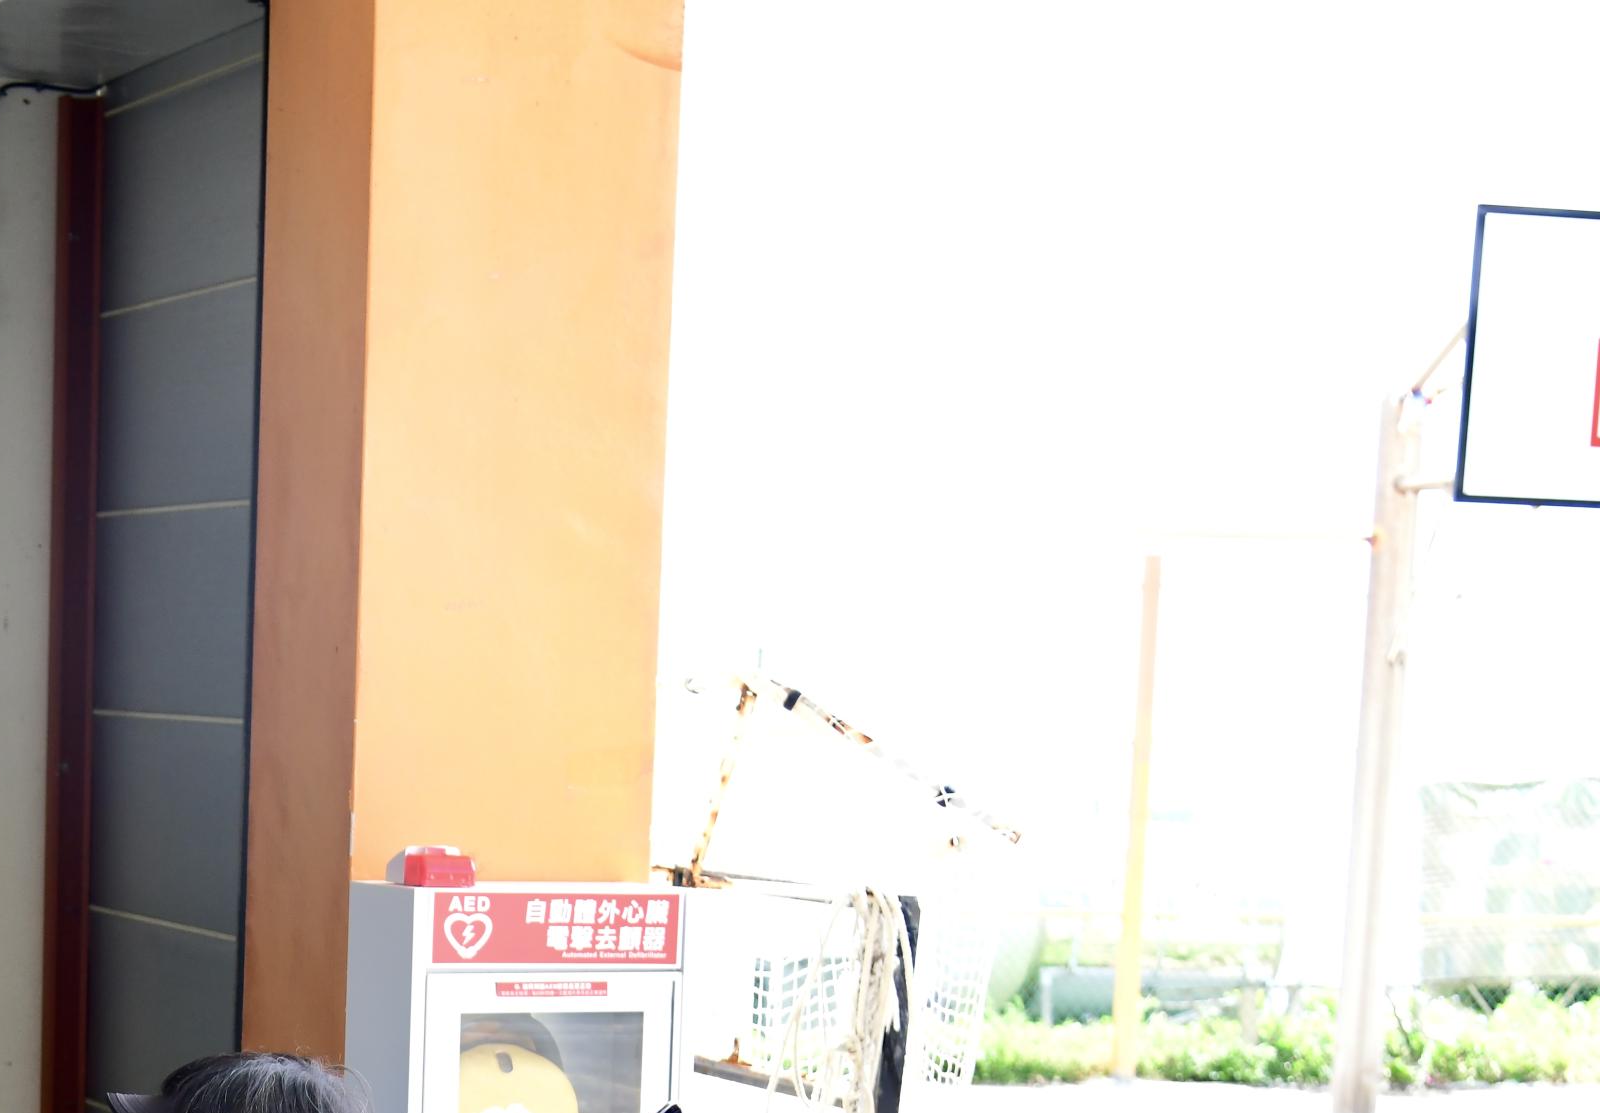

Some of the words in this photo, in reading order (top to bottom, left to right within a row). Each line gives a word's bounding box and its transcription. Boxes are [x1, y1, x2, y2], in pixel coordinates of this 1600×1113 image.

[448, 896, 491, 912] AED
[525, 898, 670, 925] 自動體外心臟
